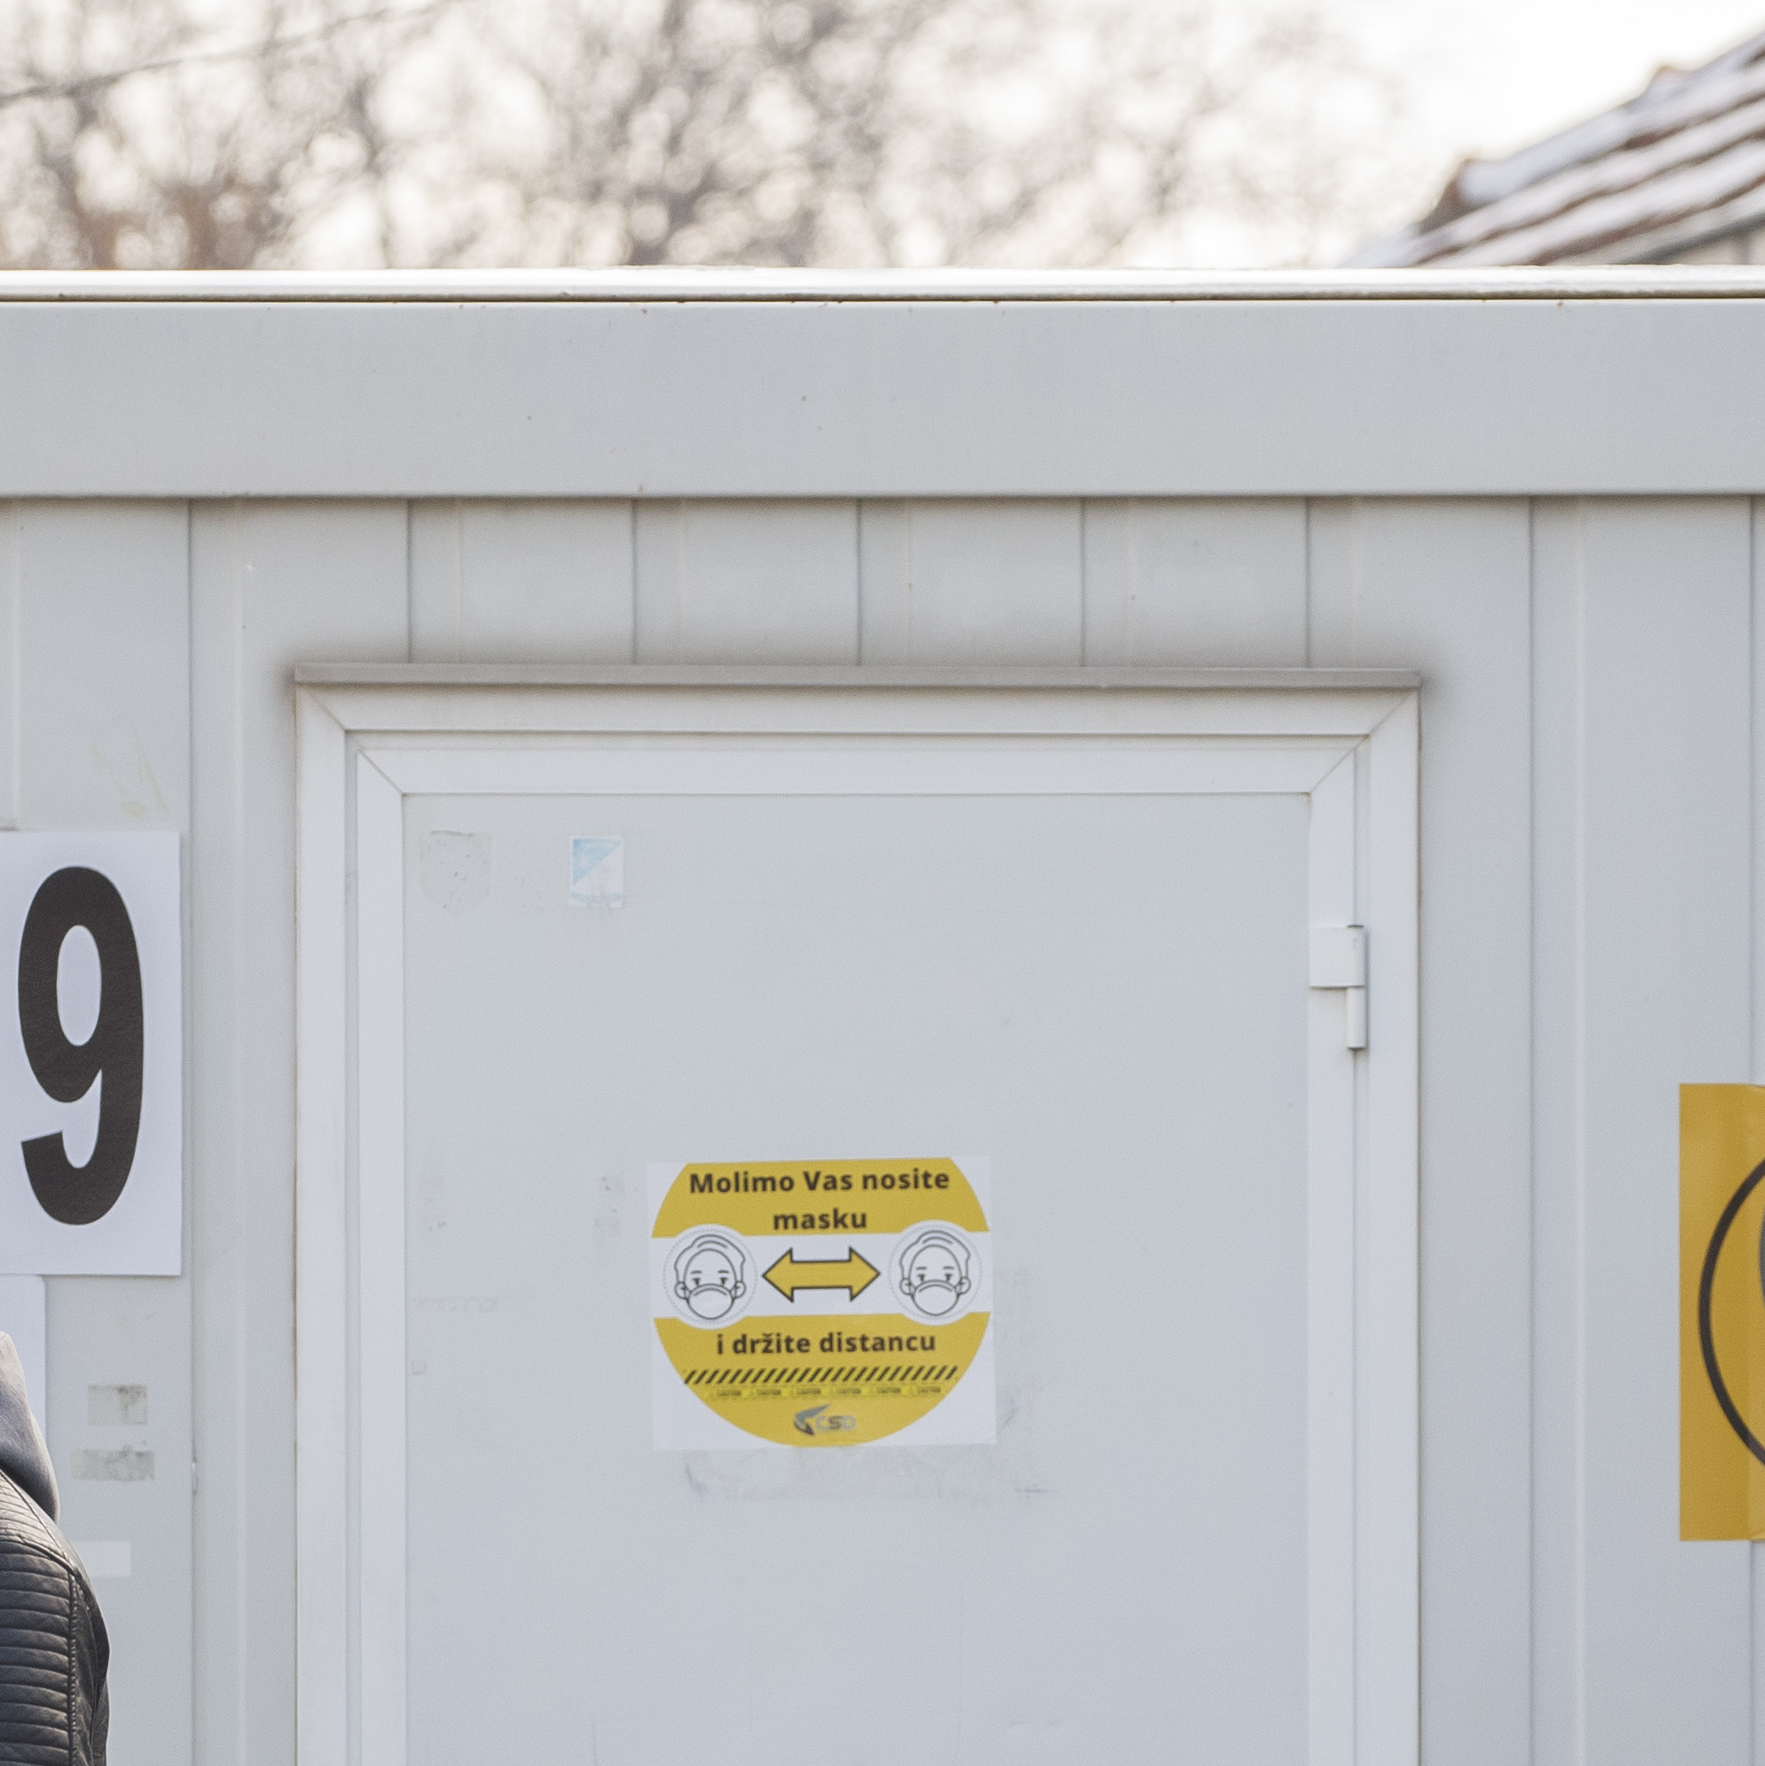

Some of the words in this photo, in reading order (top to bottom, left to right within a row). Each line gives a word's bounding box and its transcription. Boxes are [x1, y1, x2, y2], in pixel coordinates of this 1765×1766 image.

[690, 1172, 794, 1194] Molimo
[803, 1171, 852, 1191] Vas
[863, 1168, 950, 1190] nosite
[773, 1208, 867, 1230] masku
[717, 1334, 724, 1355] i
[732, 1332, 810, 1354] držite
[819, 1332, 936, 1353] distancu
